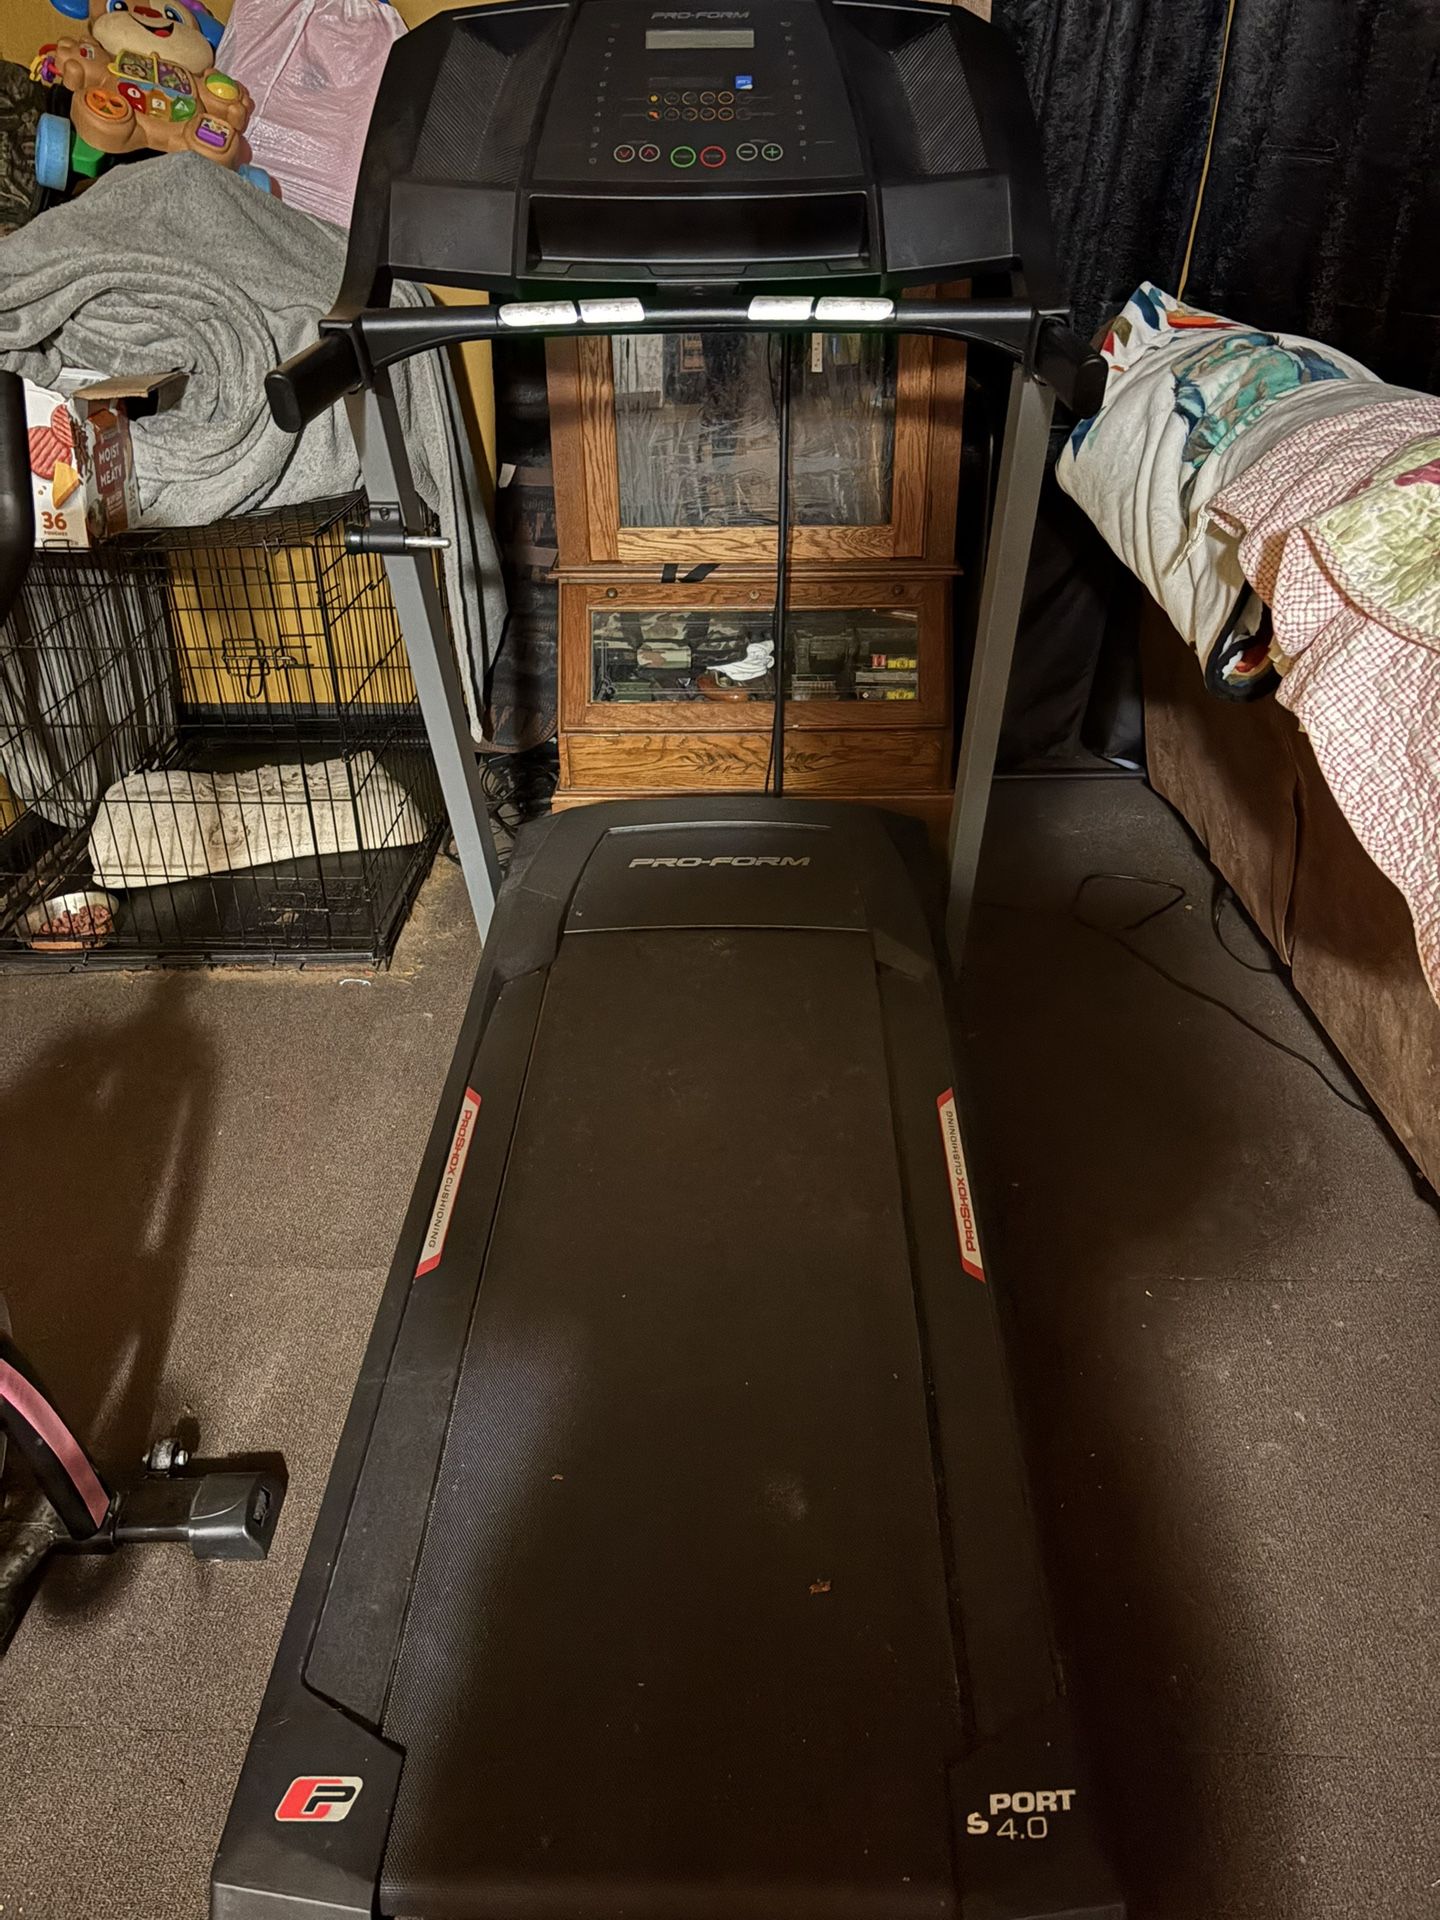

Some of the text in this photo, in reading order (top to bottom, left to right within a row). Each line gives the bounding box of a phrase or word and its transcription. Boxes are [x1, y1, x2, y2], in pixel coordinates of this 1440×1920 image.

[651, 12, 750, 20] PRO-FORM
[98, 443, 120, 465] MOIST
[100, 464, 122, 487] MEATY
[41, 511, 67, 530] 36
[628, 856, 811, 868] PRO-FORM
[428, 1109, 472, 1248] PROSHOX CUSHIONING
[946, 1111, 976, 1252] PROSHOX CUSHIONING
[996, 1816, 1048, 1840] 4.0
